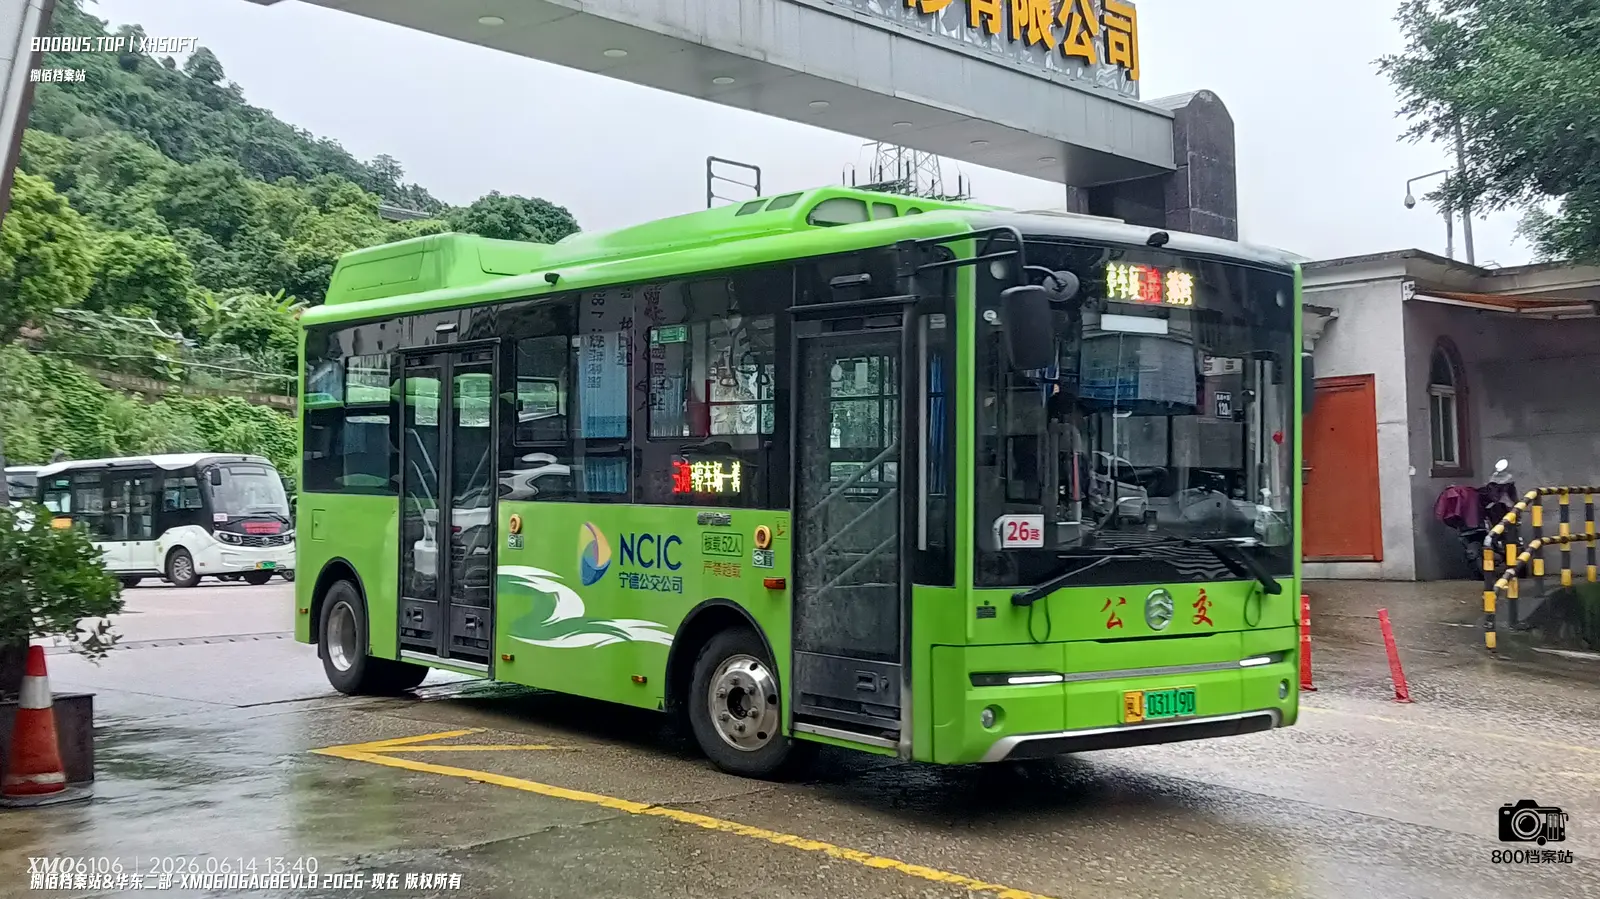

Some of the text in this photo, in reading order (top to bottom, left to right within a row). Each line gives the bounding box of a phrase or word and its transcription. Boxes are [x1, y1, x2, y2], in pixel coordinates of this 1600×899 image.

[619, 532, 683, 571] NCIC
[618, 571, 683, 594] 宁德公交公司
[1100, 588, 1213, 629] 公 交
